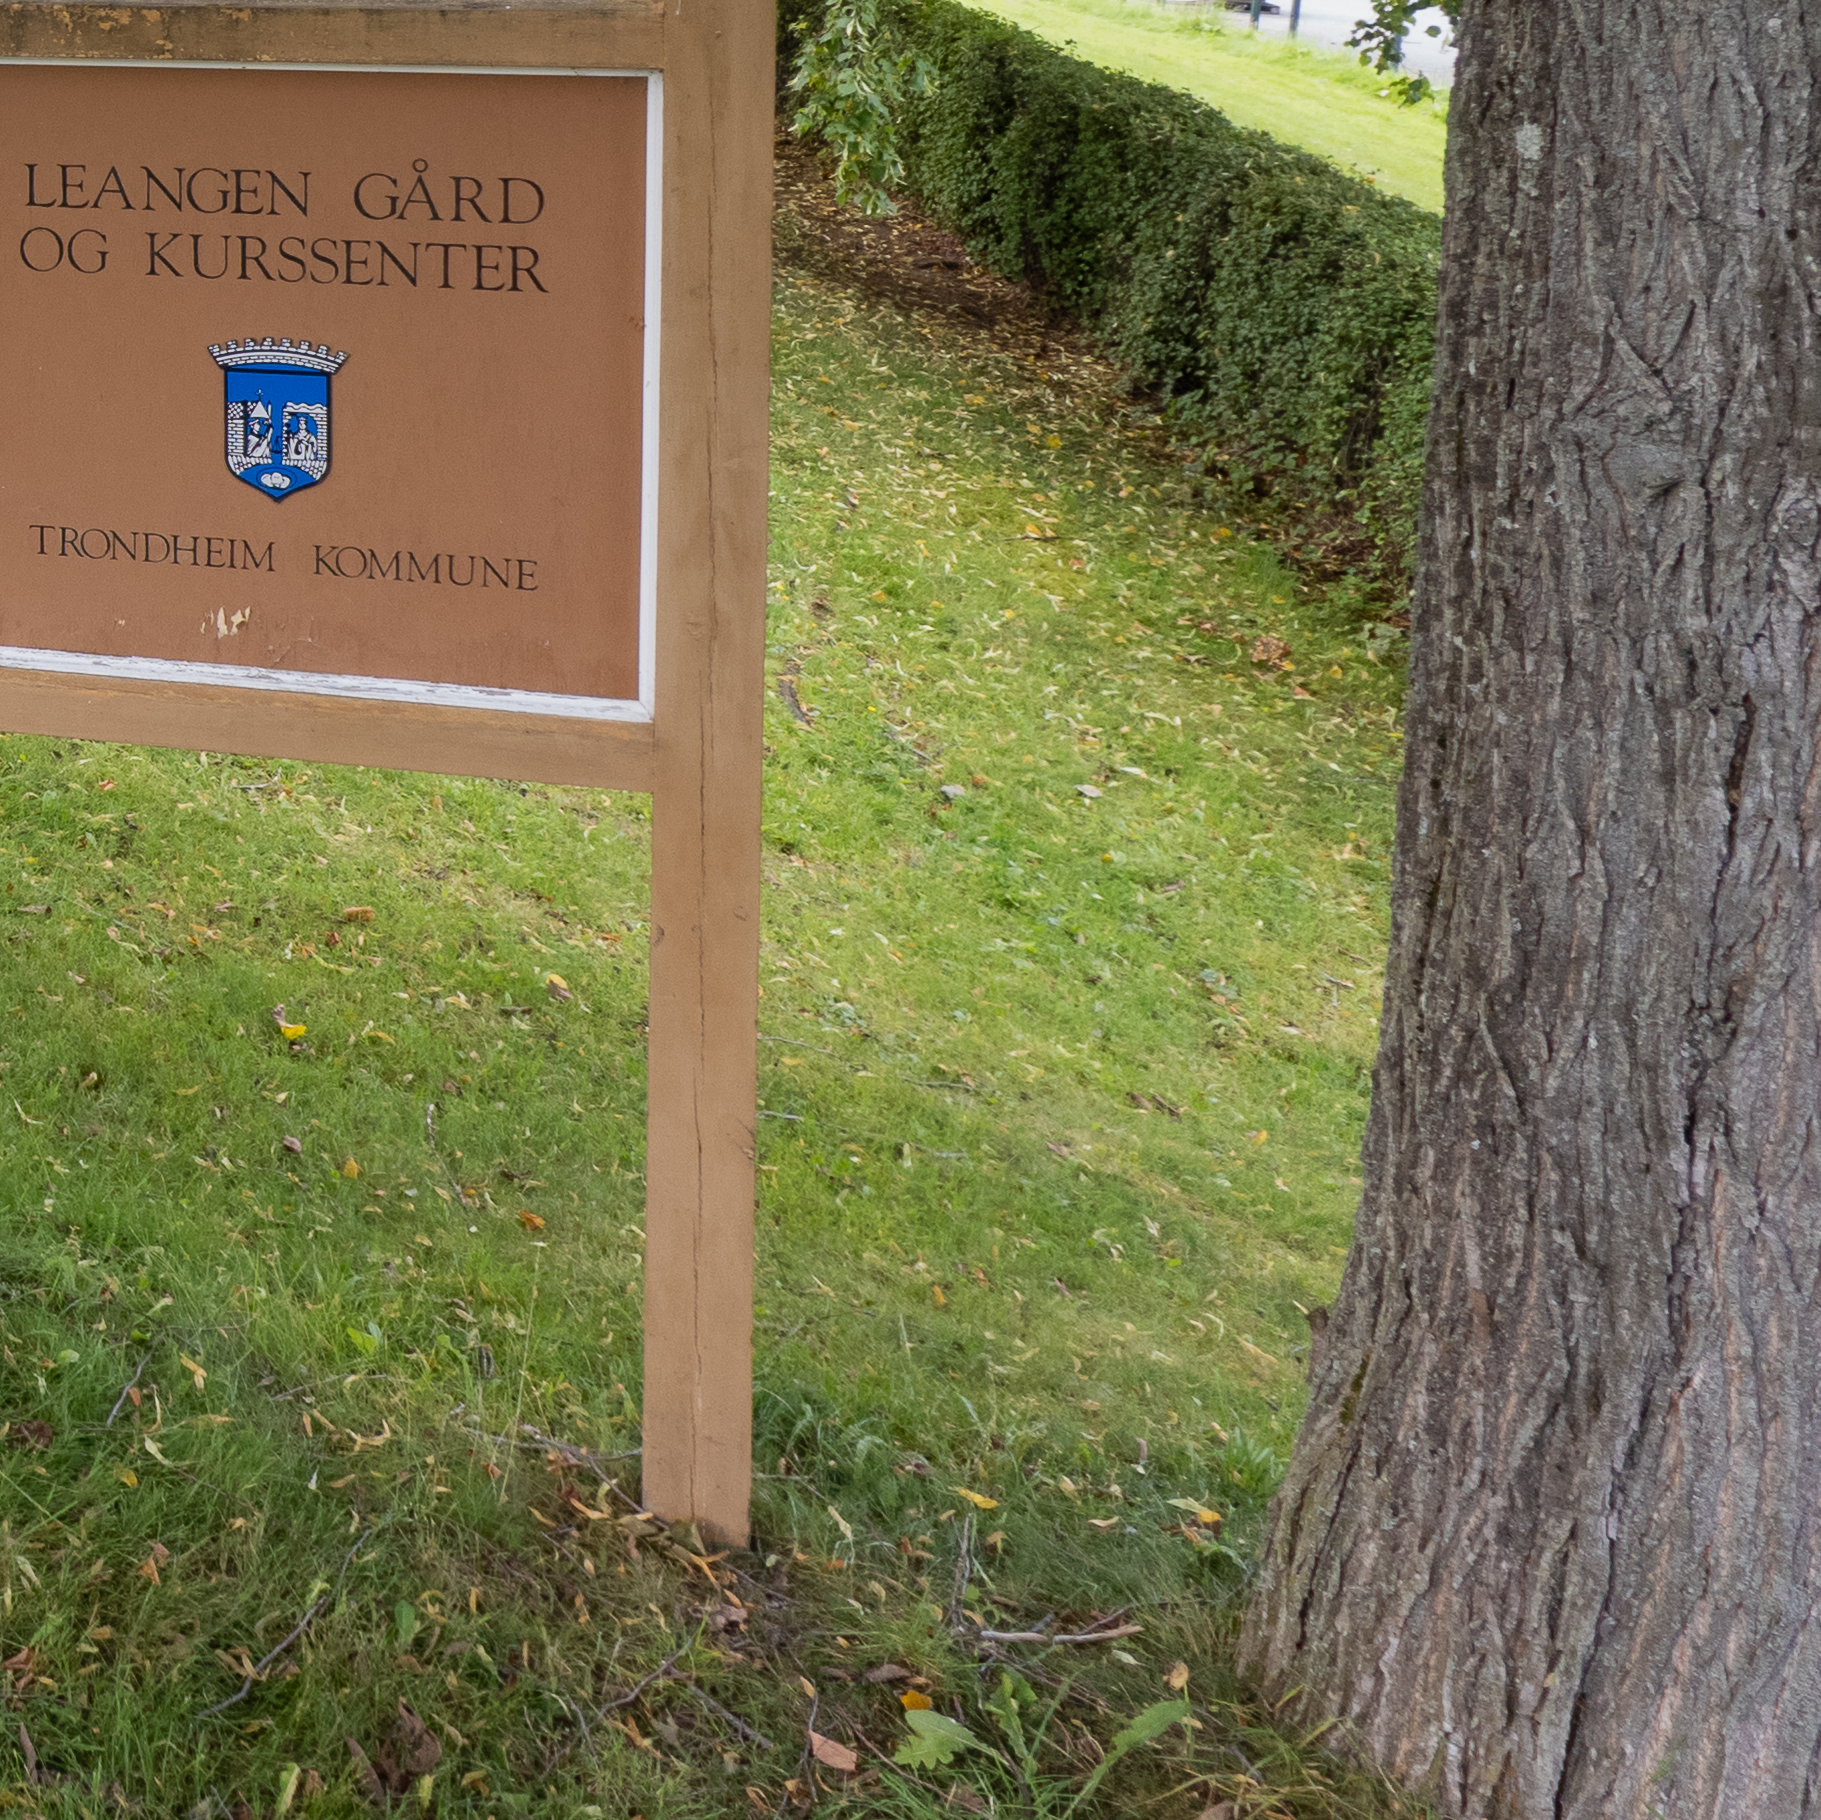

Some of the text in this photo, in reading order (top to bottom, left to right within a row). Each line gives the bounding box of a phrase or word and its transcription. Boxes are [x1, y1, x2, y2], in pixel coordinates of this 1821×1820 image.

[24, 158, 545, 225] LEANGEN GÅRD
[20, 226, 550, 294] OG KURSSENTER
[29, 524, 539, 592] TRONDHEIM KOMMUNE
